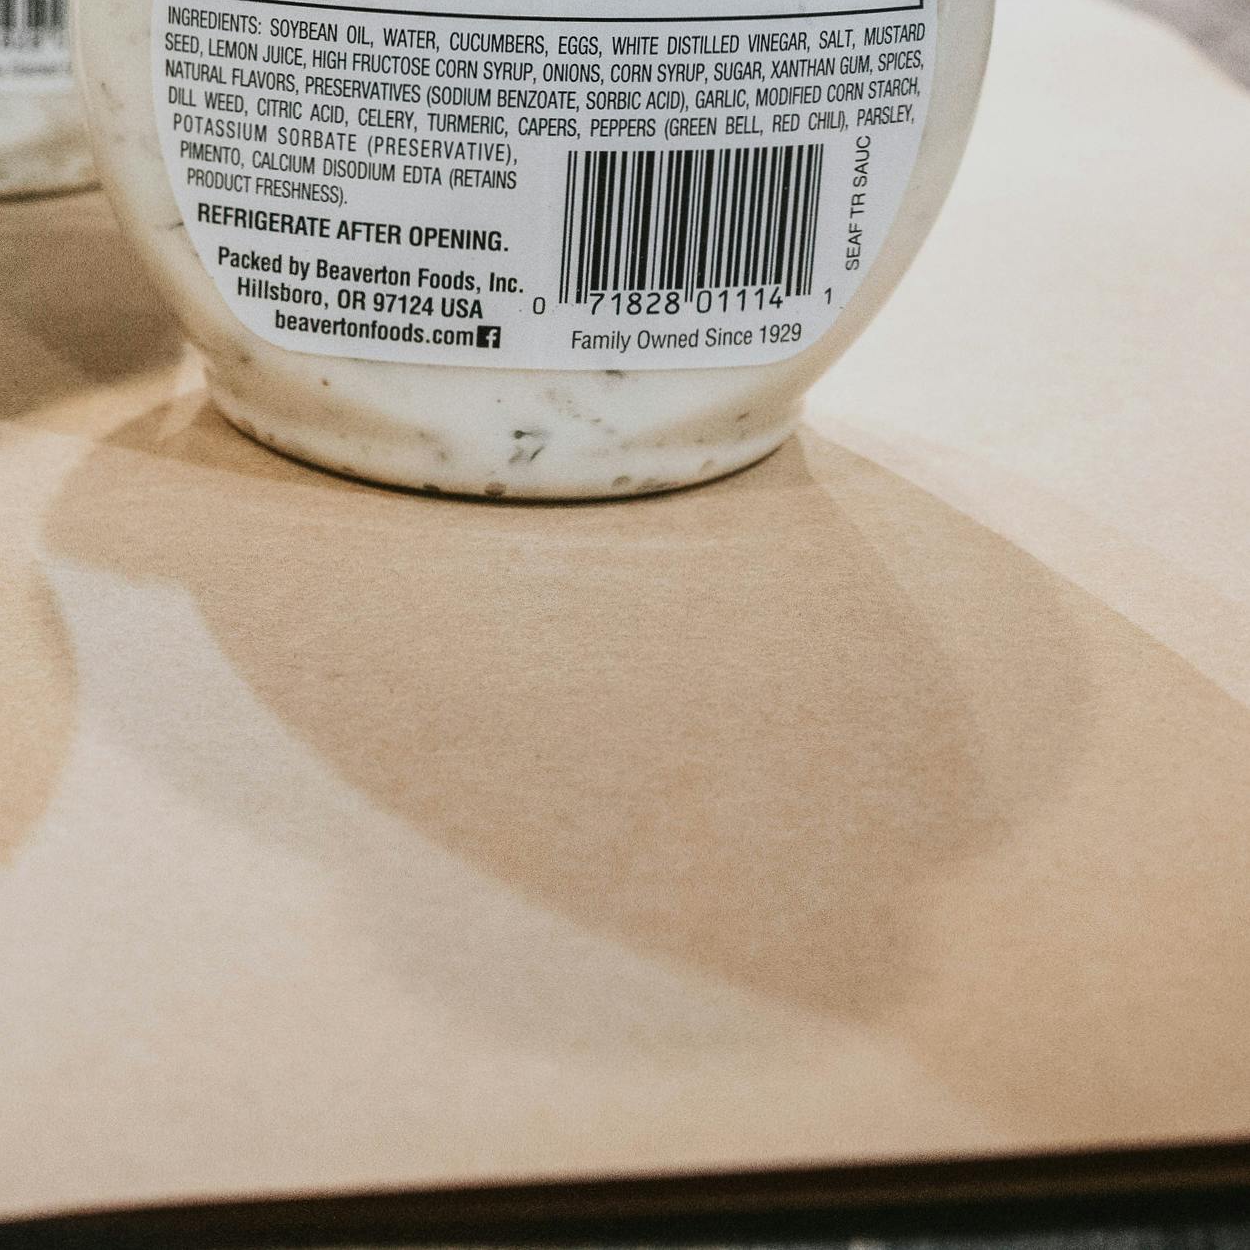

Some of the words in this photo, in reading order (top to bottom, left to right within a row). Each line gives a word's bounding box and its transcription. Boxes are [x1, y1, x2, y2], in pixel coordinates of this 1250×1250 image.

[174, 113, 267, 142] POTASSIUM
[278, 127, 357, 152] SORBATE
[368, 135, 517, 166] (PRESERVATIVE),
[853, 136, 871, 187] SAUC
[181, 140, 244, 169] PIMENTO,
[252, 150, 315, 174] CALCIUM
[323, 158, 395, 182] DISODIUM
[403, 165, 442, 185] EDTA
[449, 168, 517, 190] (RETAINS
[187, 167, 252, 193] PRODUCT
[256, 177, 347, 207] FRESHNESS).
[198, 202, 330, 238] REFRIGERATE
[337, 220, 401, 245] AFTER
[409, 226, 508, 252] OPENING.
[850, 193, 865, 217] TR
[845, 218, 863, 271] SEAF
[218, 246, 282, 274] Packed
[289, 256, 310, 279] by
[316, 258, 410, 287] Beaverton
[418, 268, 481, 294] Foods,
[489, 272, 523, 293] Inc.
[238, 276, 328, 310] Hillsboro,
[337, 289, 366, 311] OR
[373, 292, 434, 316] 97124
[441, 297, 483, 319] USA
[532, 297, 545, 314] 0
[590, 293, 681, 315] 71828
[696, 288, 783, 313] 01114
[824, 288, 832, 304] 1
[275, 309, 474, 346] beavertonfoods.com
[572, 331, 631, 353] Family
[637, 328, 699, 349] Owned
[705, 328, 752, 347] Since
[760, 323, 801, 343] 1929
